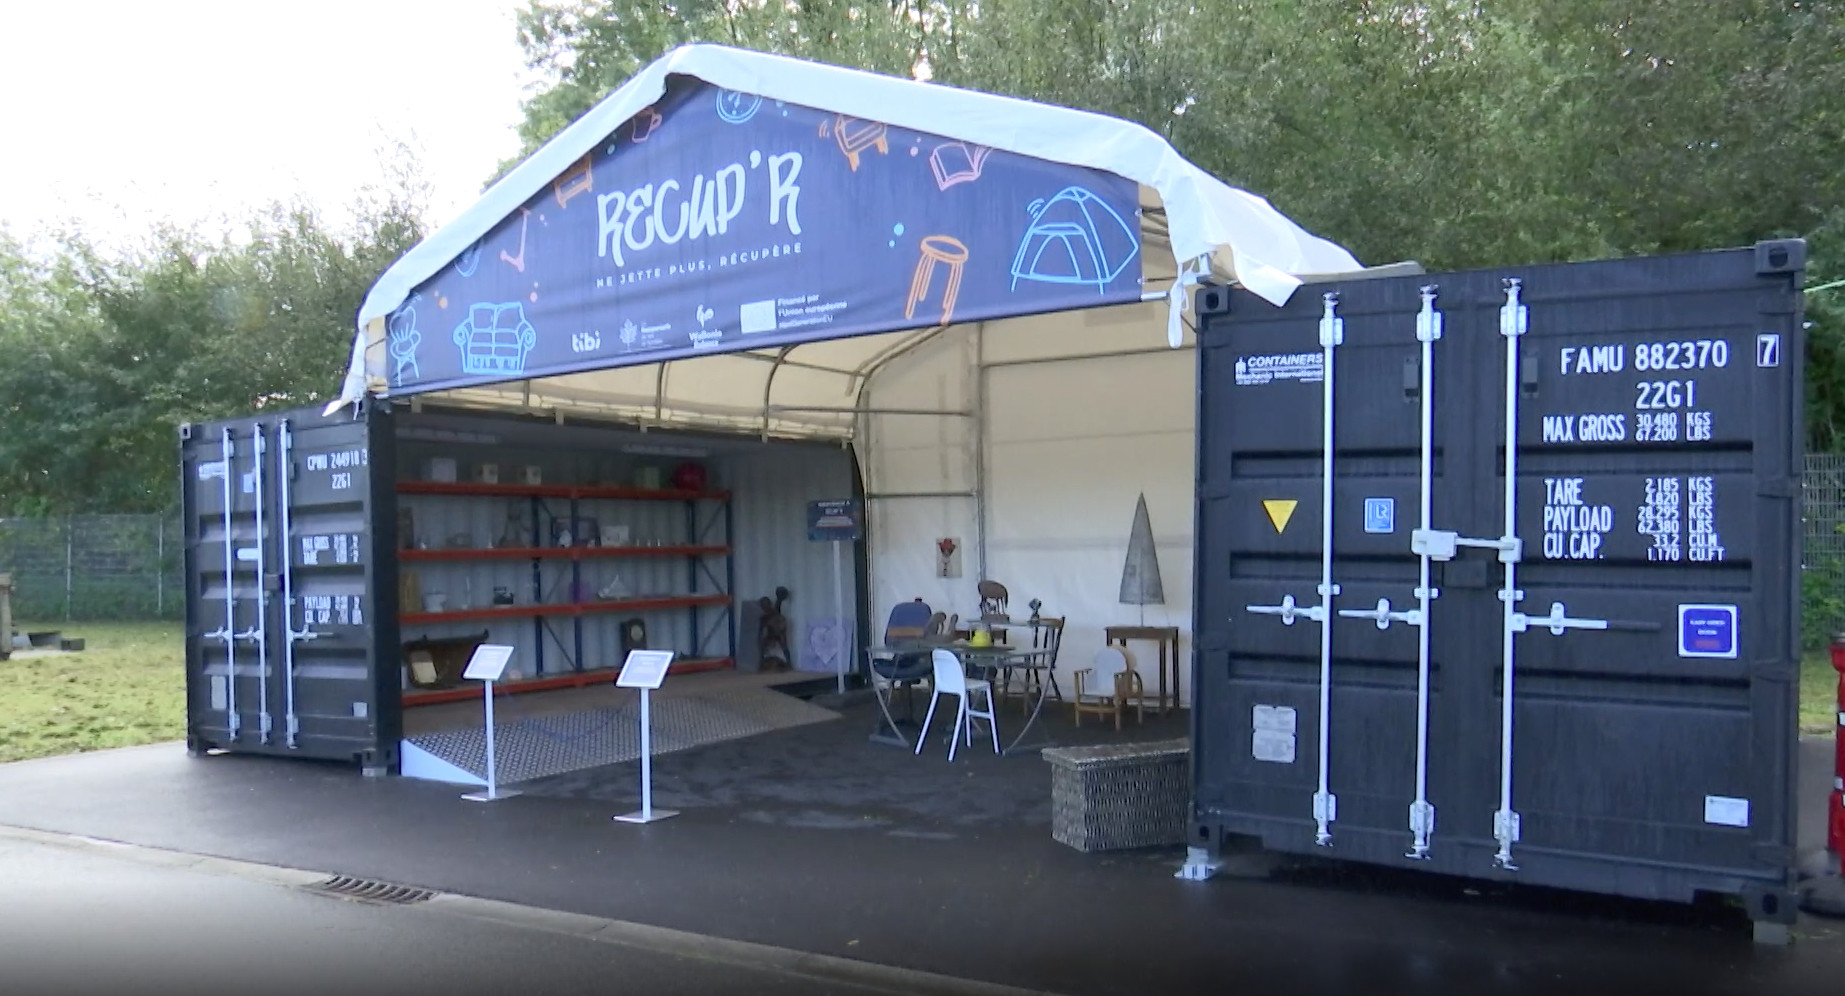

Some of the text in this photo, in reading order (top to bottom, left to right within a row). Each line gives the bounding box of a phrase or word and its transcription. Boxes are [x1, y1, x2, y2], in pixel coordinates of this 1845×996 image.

[596, 241, 803, 289] NE JETTE PLUS, RÉCUPÈRE
[571, 330, 601, 353] tibi
[1560, 336, 1775, 375] FAMU 882370 7
[1247, 352, 1324, 368] CONTAINERS
[1634, 380, 1696, 410] 22G1
[1543, 416, 1575, 443] MAX
[1578, 414, 1625, 441] GROSS
[1686, 411, 1711, 426] KGS
[1635, 425, 1711, 442] 67.200 LBS
[1544, 478, 1583, 506] TARE
[1687, 476, 1713, 492] KGS
[1688, 491, 1713, 506] LBS
[1543, 505, 1612, 533] PAYLOAD
[1688, 506, 1713, 520] KGS
[1688, 520, 1713, 534] LBS
